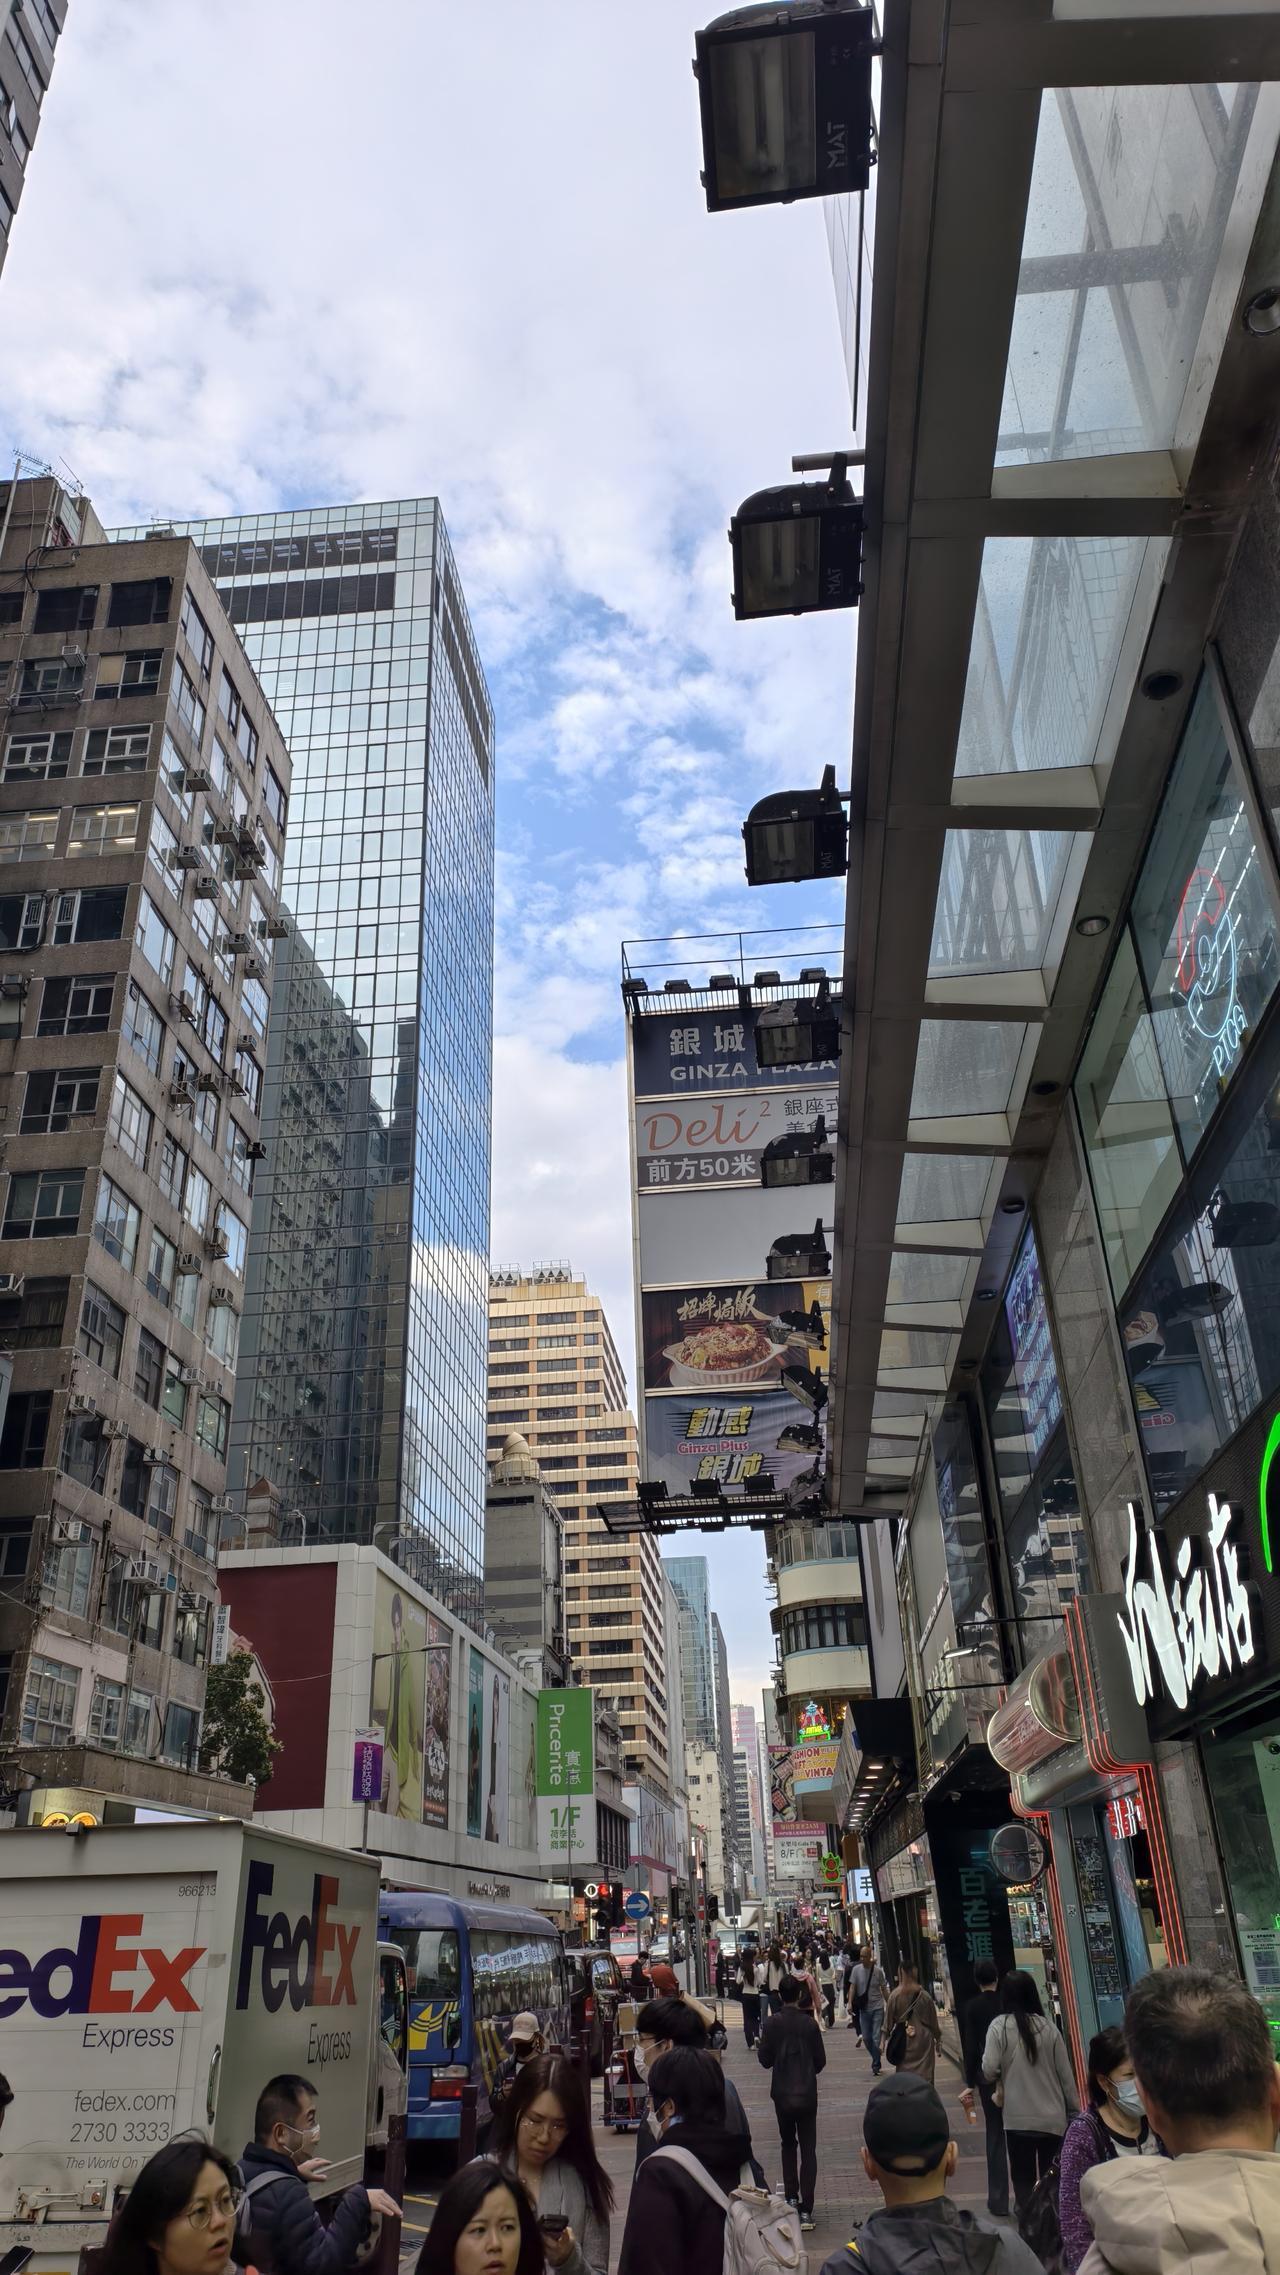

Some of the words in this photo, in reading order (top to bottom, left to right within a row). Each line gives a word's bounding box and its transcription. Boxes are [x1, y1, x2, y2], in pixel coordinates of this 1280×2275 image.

[826, 121, 846, 168] MAT
[670, 1062, 747, 1081] GINZA
[646, 1153, 756, 1183] 前方50米
[686, 1405, 753, 1438] 動感
[677, 1441, 718, 1455] Ginza
[720, 1439, 750, 1453] Plus
[697, 1453, 763, 1484] 銀城
[549, 1704, 565, 1786] Pricerite
[550, 1807, 581, 1828] 1/F
[550, 1839, 585, 1850] 商業中心
[551, 1829, 577, 1839] 荷李活
[780, 1848, 795, 1859] 8/F
[178, 1885, 216, 1897] 966213
[236, 1859, 361, 2013] FedEx
[82, 2023, 175, 2054] Express
[307, 2023, 351, 2072] Express
[74, 2090, 176, 2112] fedex.com
[70, 2122, 117, 2142] 2730
[123, 2121, 170, 2142] 3333
[66, 2156, 85, 2168] The
[87, 2156, 119, 2169] World
[122, 2156, 138, 2169] On
